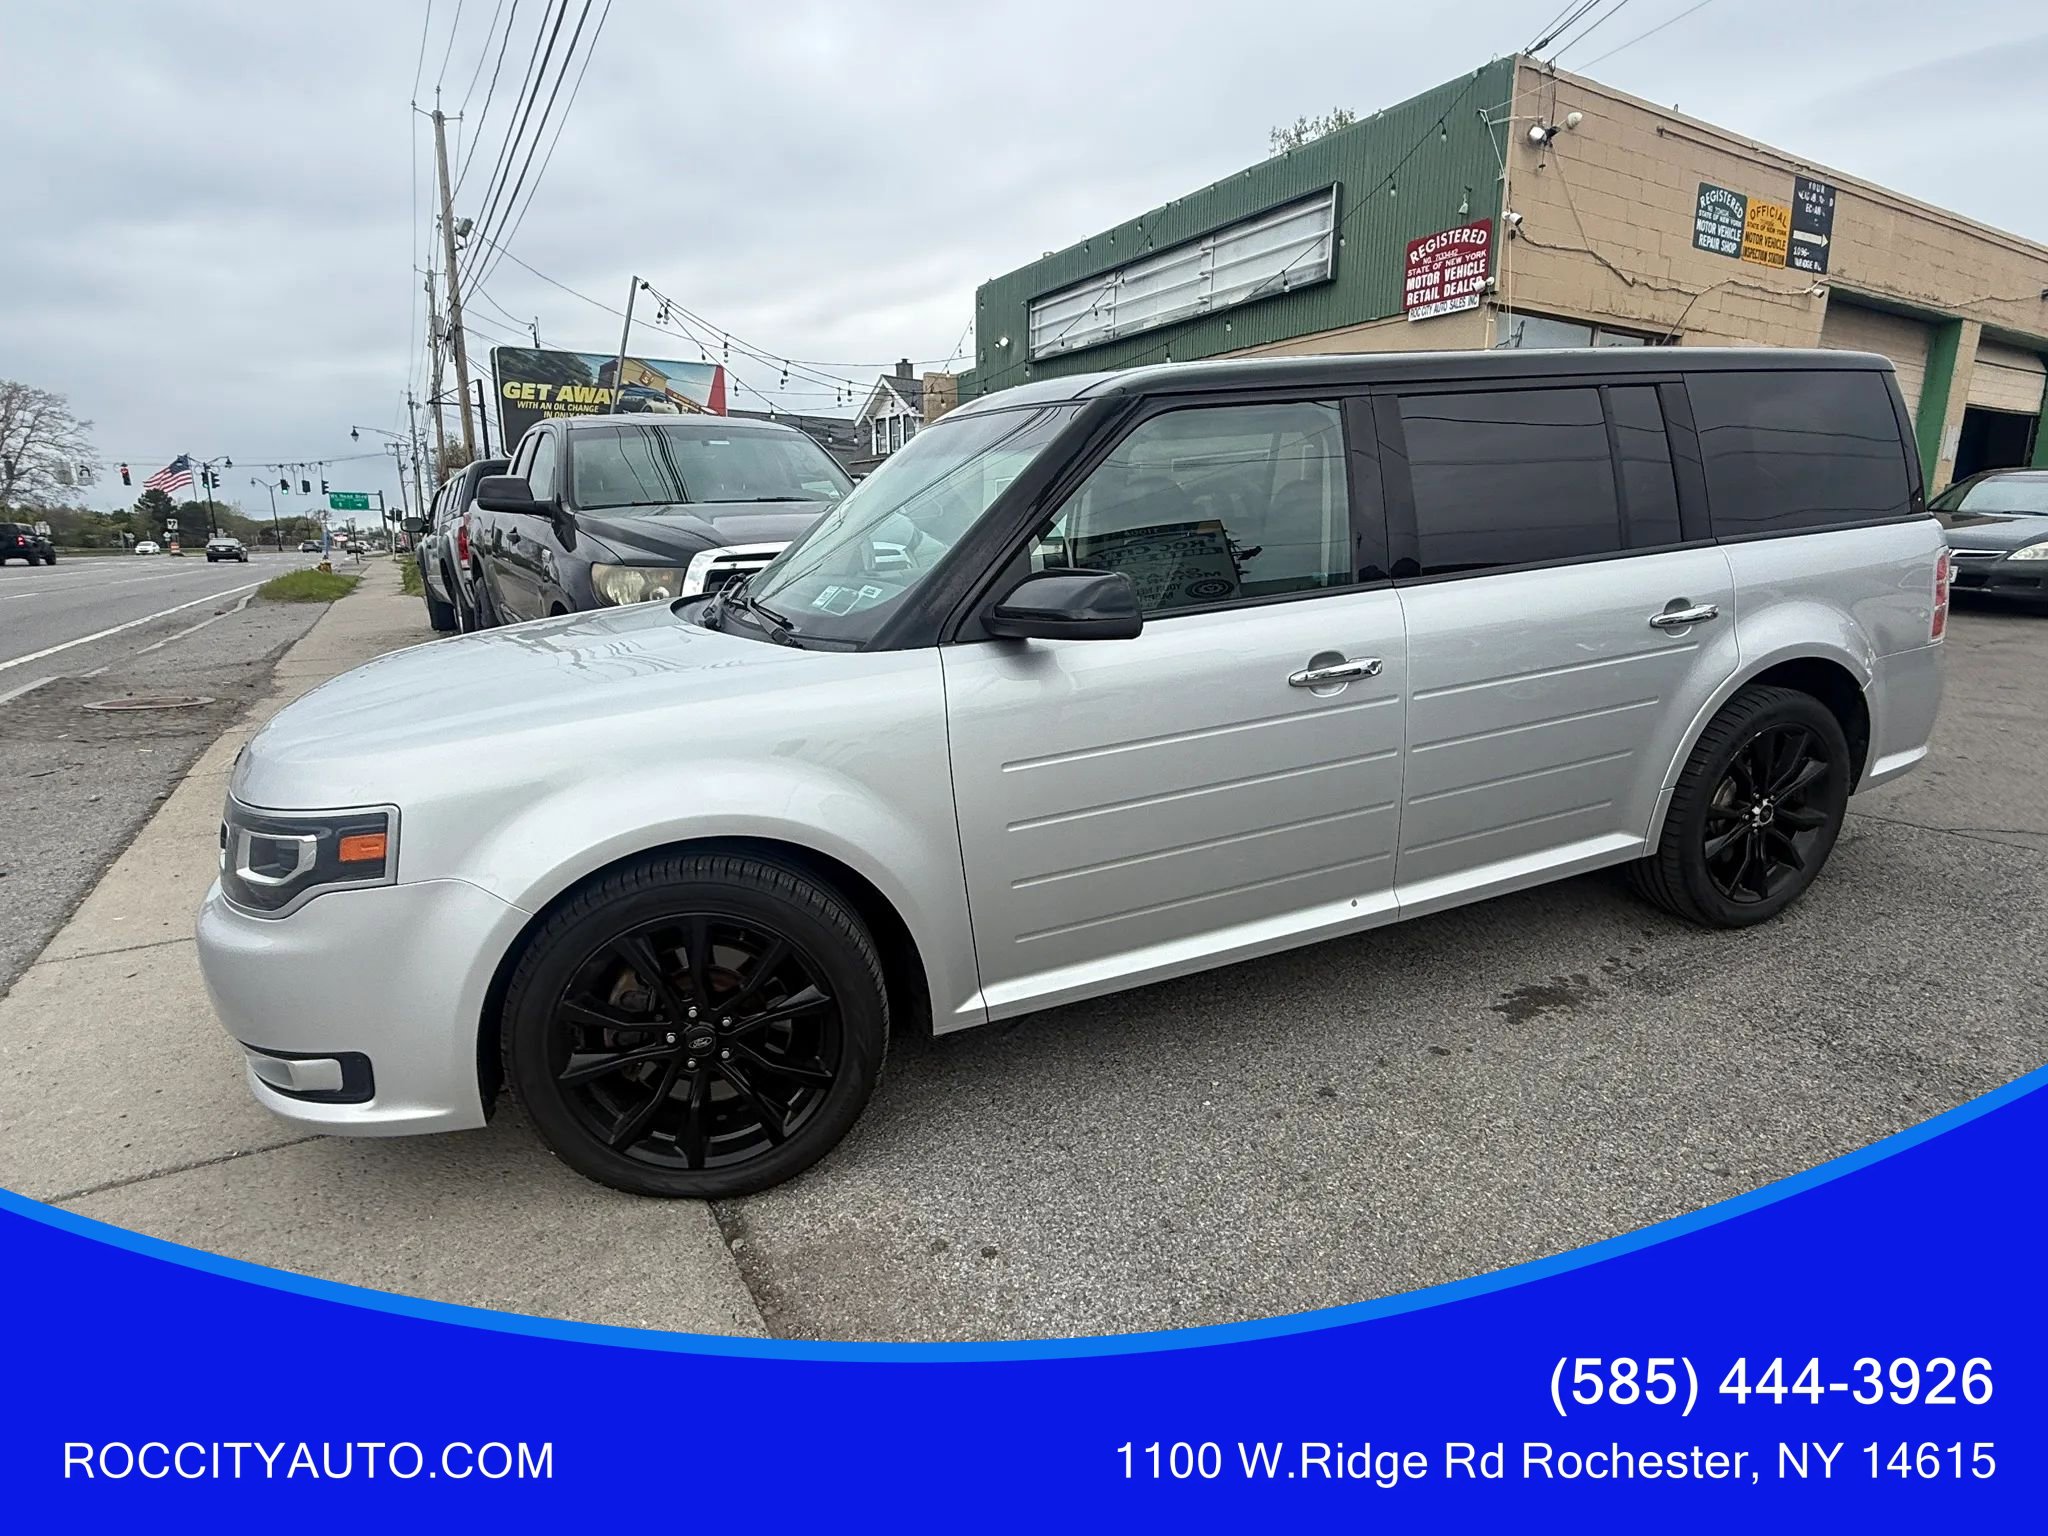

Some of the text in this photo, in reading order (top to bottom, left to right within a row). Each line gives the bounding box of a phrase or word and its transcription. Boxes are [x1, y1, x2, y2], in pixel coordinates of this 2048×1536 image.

[1700, 189, 1743, 218] REGISTERED
[1699, 209, 1712, 219] STATE
[1720, 216, 1729, 224] NEW
[1730, 219, 1741, 227] YORK
[1747, 221, 1759, 230] STATE
[1750, 205, 1786, 228] OFFICIAL
[1696, 218, 1741, 241] MOTOR VEHICLE
[1410, 229, 1487, 264] REGISTERED
[1699, 234, 1737, 254] REPAIR SHOP
[1745, 231, 1786, 251] MOTOR VEHICLE
[1408, 249, 1486, 277] STATE OF NEW YORK
[1743, 246, 1784, 265] INSPECTION STATION
[1406, 259, 1486, 291] MOTOR VEHICLE
[1406, 287, 1440, 306] RETAIL
[1434, 301, 1448, 313] AUTO
[1449, 297, 1466, 310] SALES
[503, 381, 625, 405] GET AWAY
[517, 401, 539, 409] WITH
[567, 405, 599, 413] CHANGE
[544, 411, 552, 419] IN
